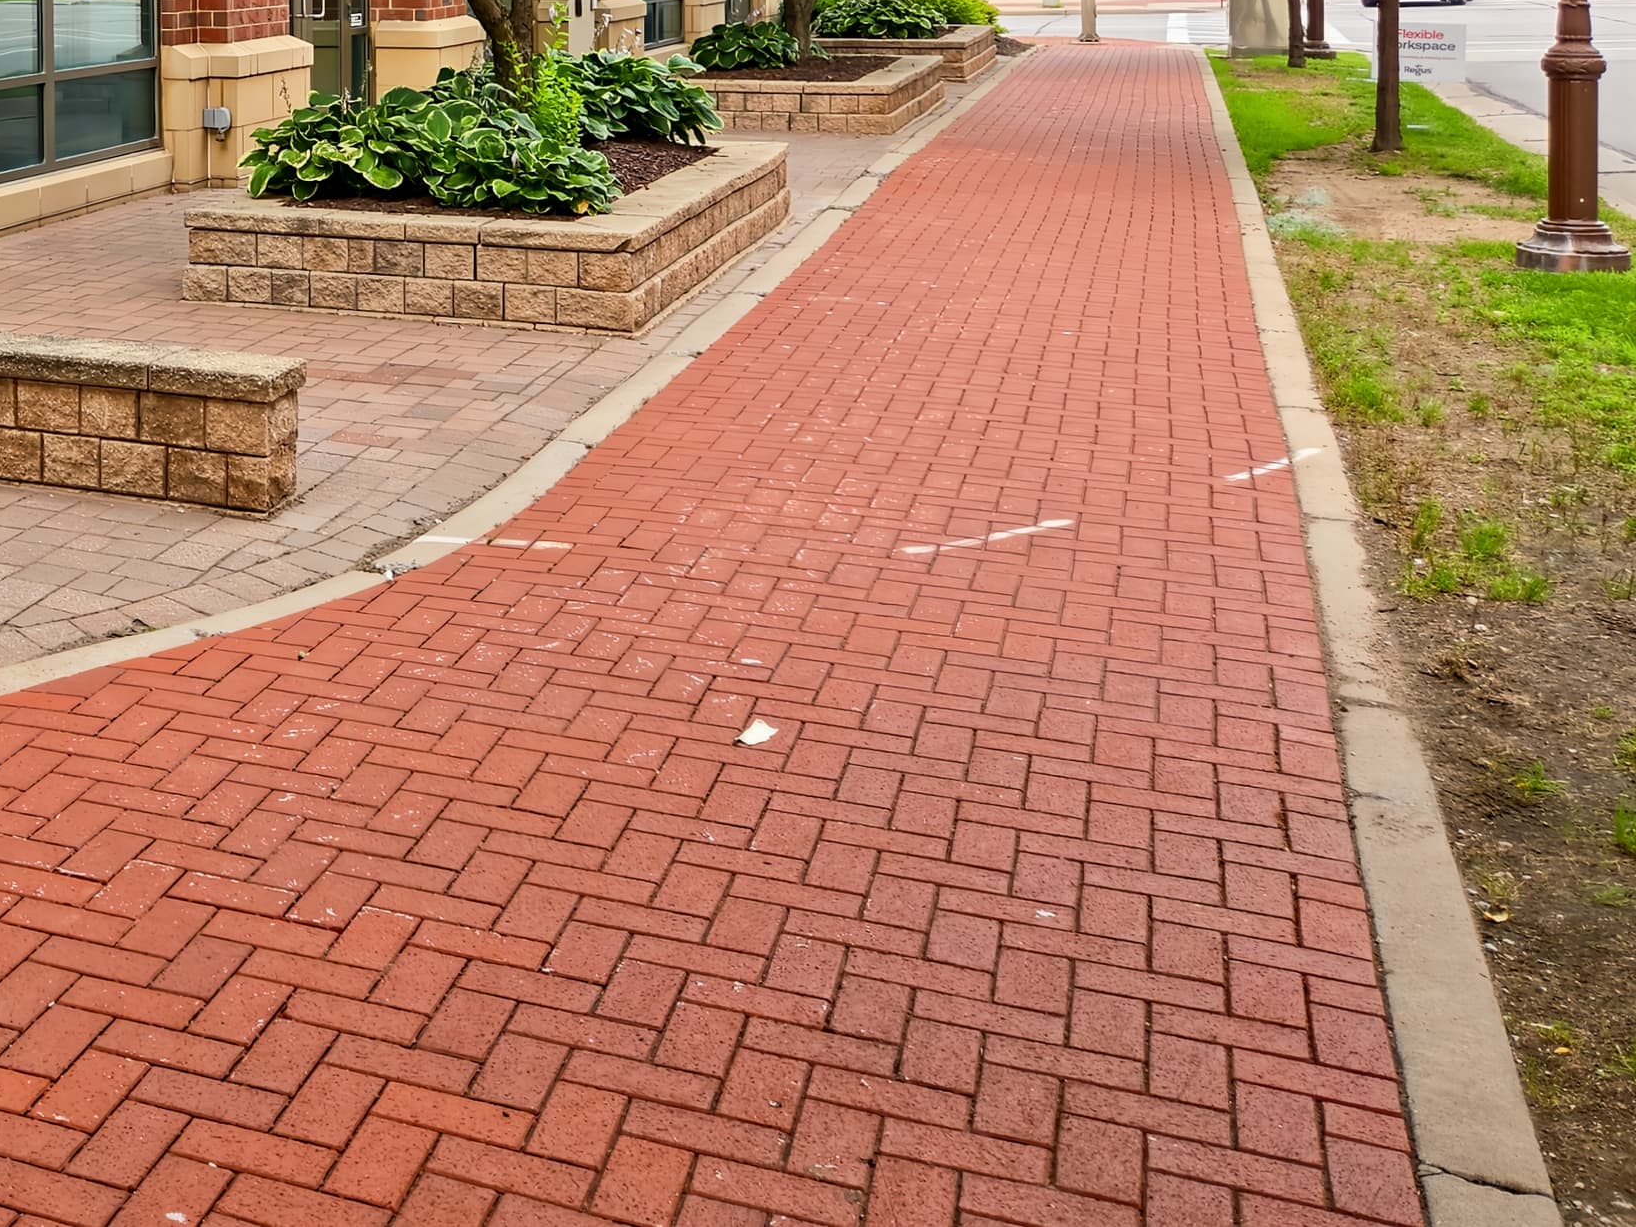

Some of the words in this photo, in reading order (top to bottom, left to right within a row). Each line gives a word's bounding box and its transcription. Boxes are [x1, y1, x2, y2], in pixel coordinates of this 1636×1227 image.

[1398, 28, 1444, 40] Flexible
[1397, 40, 1456, 52] orkspace
[1404, 64, 1432, 76] Regus
